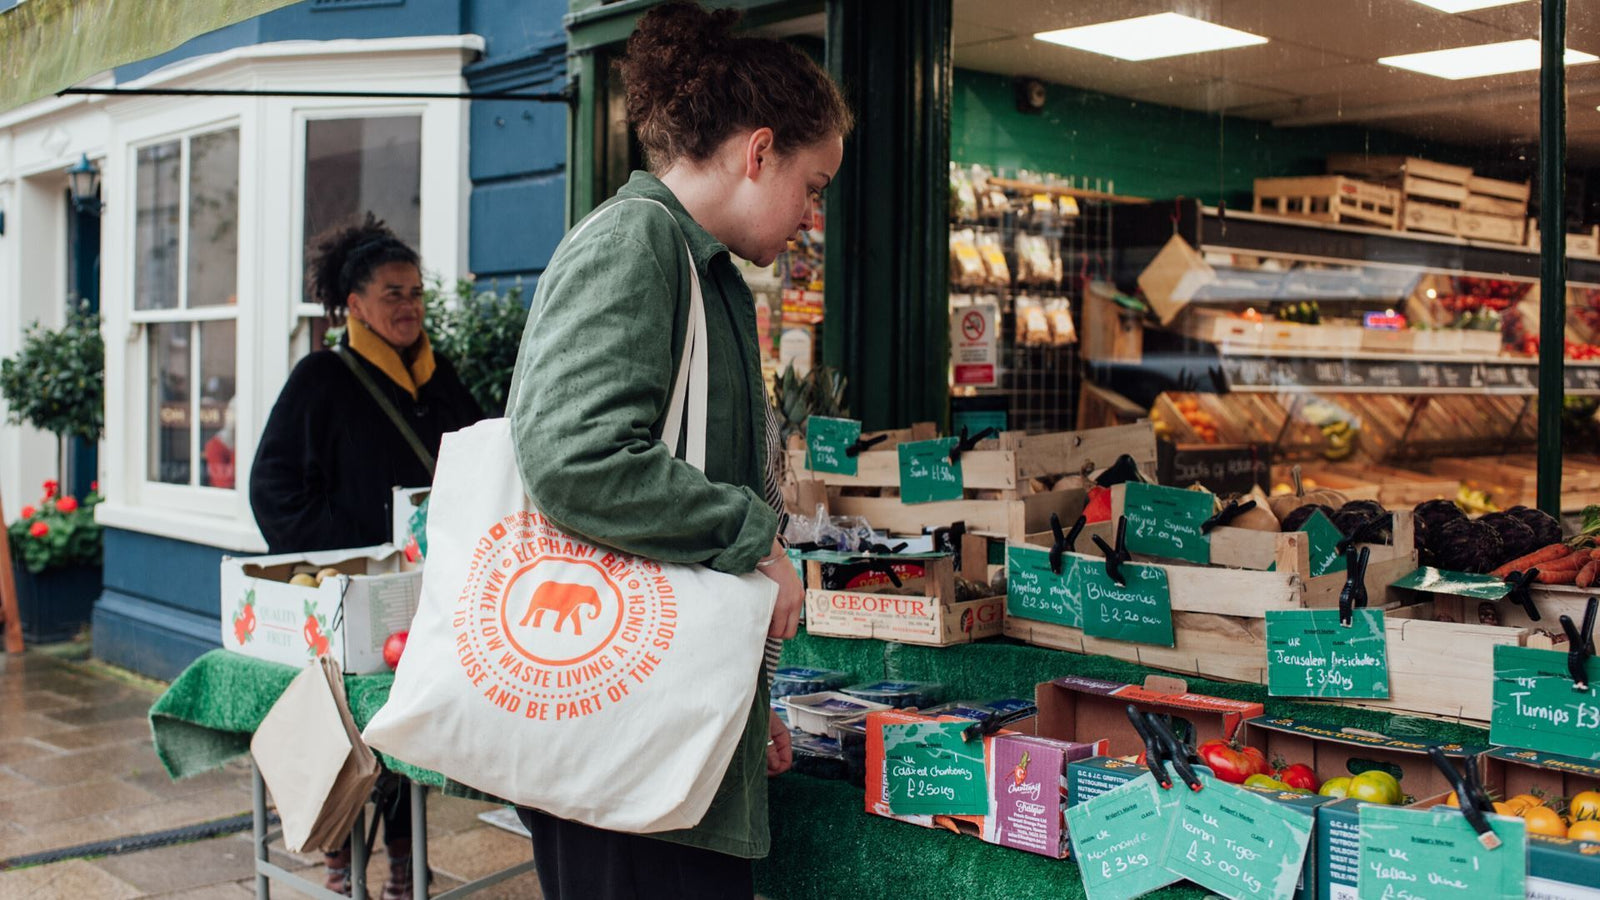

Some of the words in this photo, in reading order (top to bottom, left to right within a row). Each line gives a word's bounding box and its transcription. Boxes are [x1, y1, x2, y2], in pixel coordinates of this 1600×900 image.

[601, 552, 634, 581] BOX
[480, 568, 508, 613] MAKE
[831, 594, 928, 617] GEOFUR
[1086, 582, 1157, 606] Blueberries
[479, 618, 506, 652] LOW
[621, 595, 646, 643] CINCH
[456, 631, 489, 688] REUSE
[483, 683, 522, 714] AND
[525, 700, 550, 721] BE
[556, 693, 603, 721] PART
[607, 679, 630, 703] OF
[628, 650, 662, 684] THE
[652, 574, 678, 651] SOLUTION
[612, 644, 629, 659] A
[1274, 650, 1327, 667] Jerusalem
[499, 651, 552, 689] WASTE
[557, 654, 615, 689] LIVING
[1508, 691, 1570, 726] Turnips
[1224, 838, 1262, 861] Tiger
